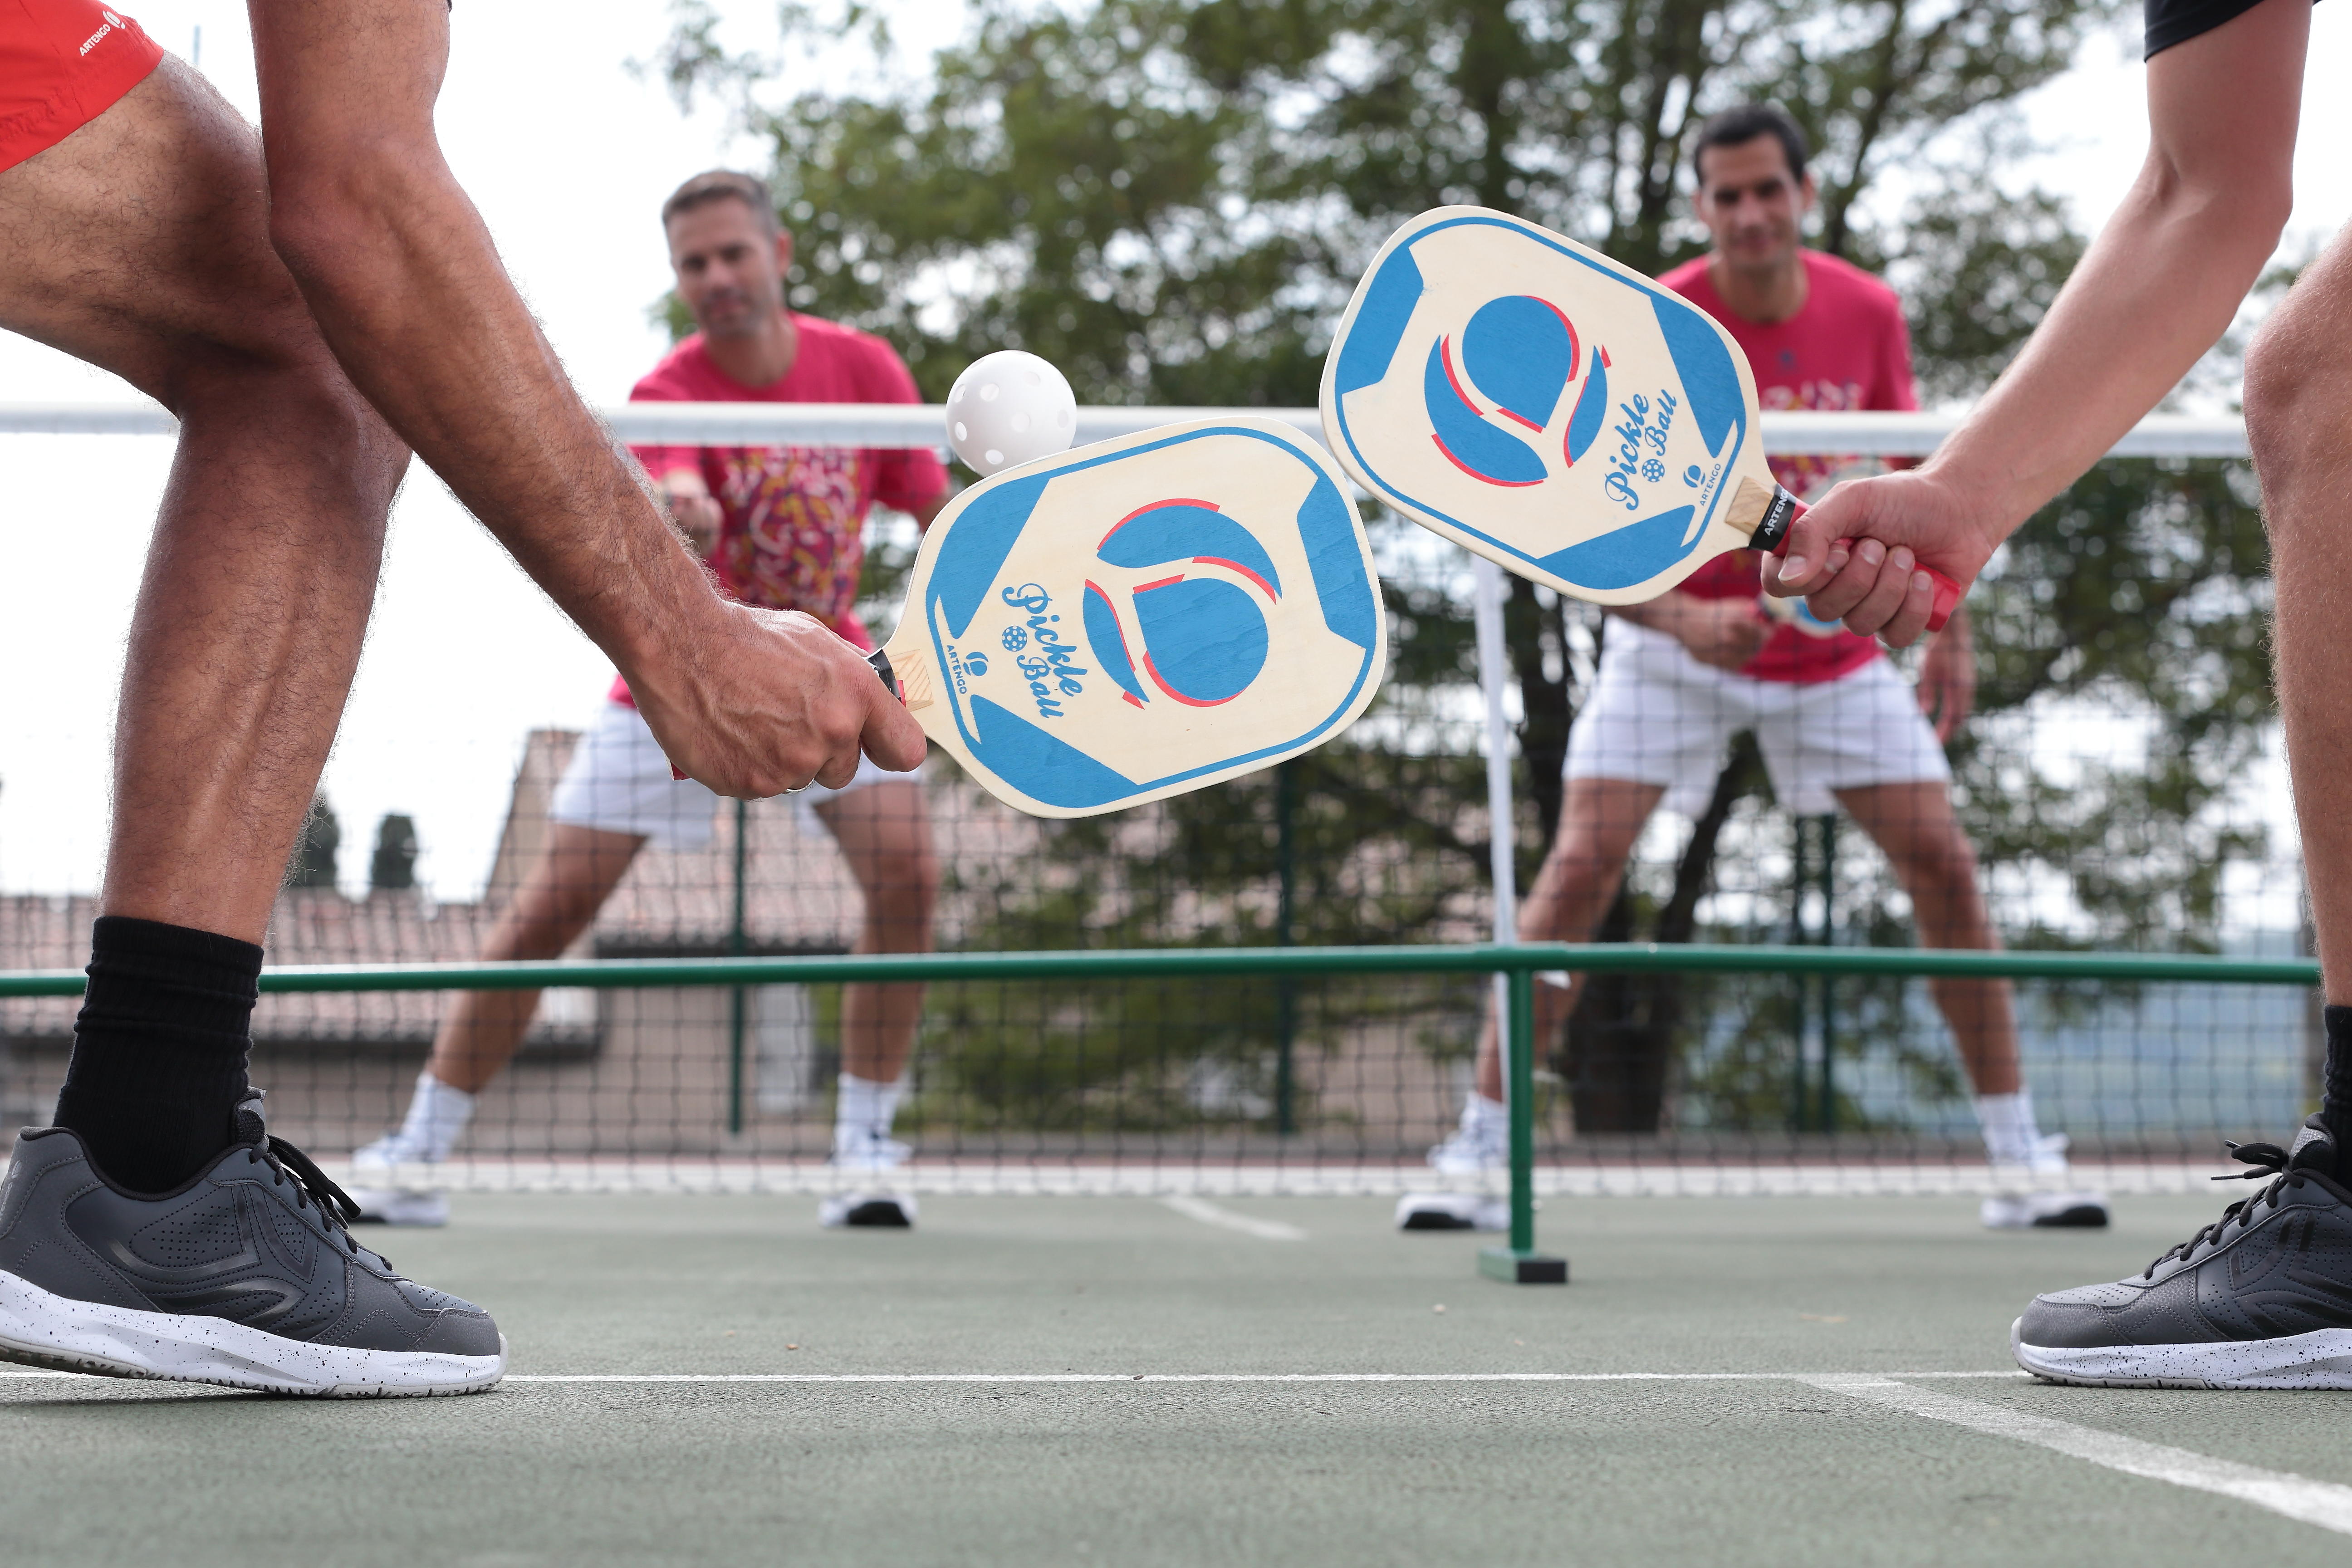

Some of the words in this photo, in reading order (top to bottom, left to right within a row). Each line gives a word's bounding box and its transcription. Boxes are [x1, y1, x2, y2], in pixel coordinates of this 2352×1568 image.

[79, 24, 111, 56] ARTENGO
[1605, 393, 1649, 510] Pickle
[1645, 389, 1677, 456] Ball
[1700, 463, 1721, 506] ARTENGO
[1002, 583, 1087, 696] Pickle
[947, 645, 967, 694] ARTENGO
